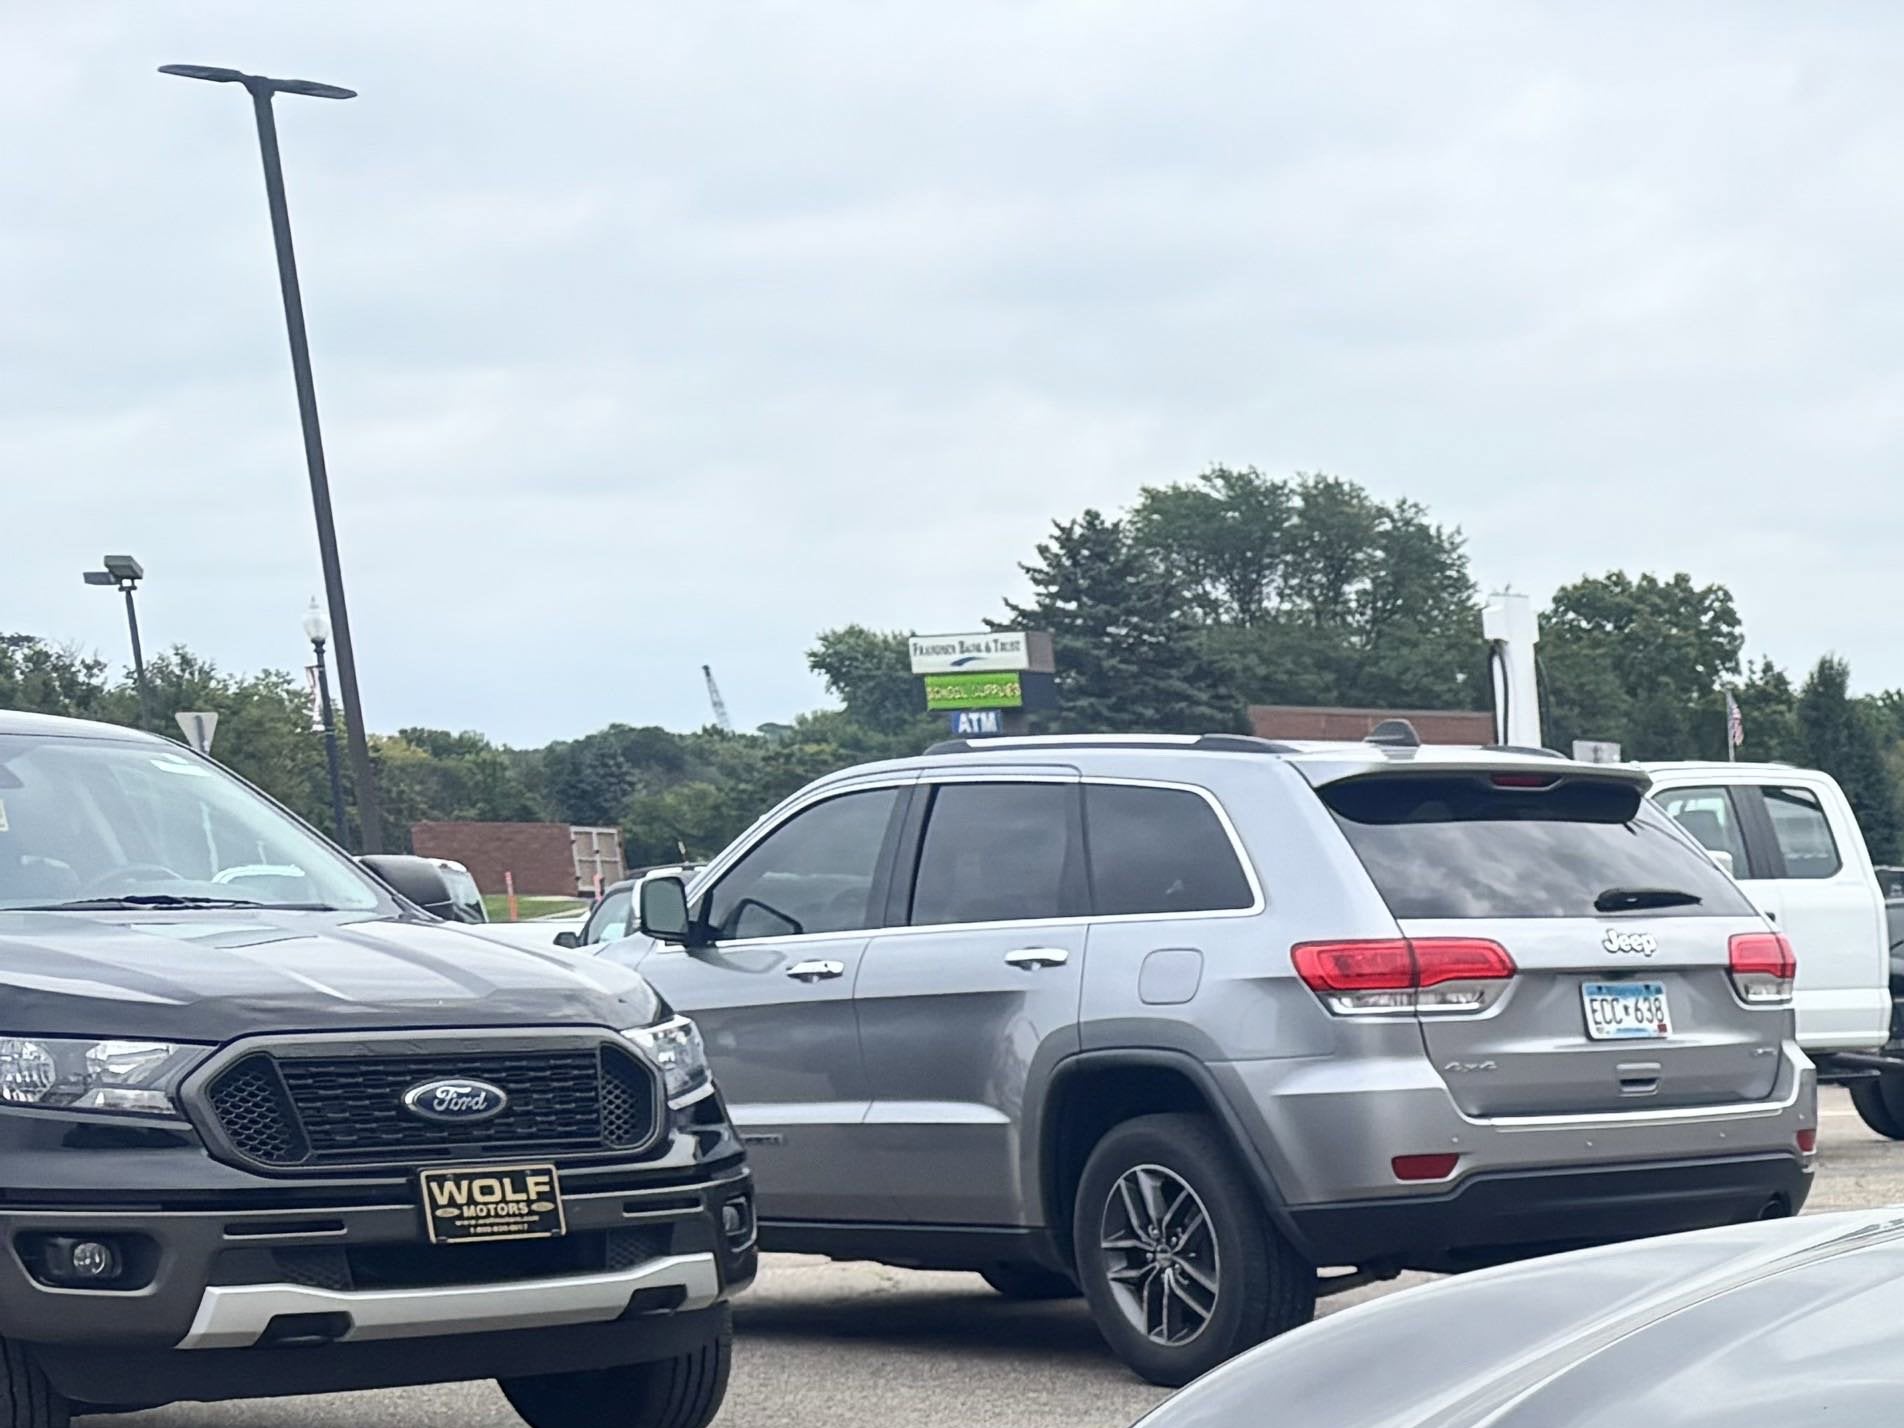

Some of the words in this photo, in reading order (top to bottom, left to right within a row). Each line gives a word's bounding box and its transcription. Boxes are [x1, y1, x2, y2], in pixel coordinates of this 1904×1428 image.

[958, 711, 998, 734] ATM
[1602, 928, 1657, 957] Jeep
[432, 1086, 488, 1112] Ford
[429, 1175, 550, 1206] WOLF
[462, 1202, 529, 1218] MOTORS
